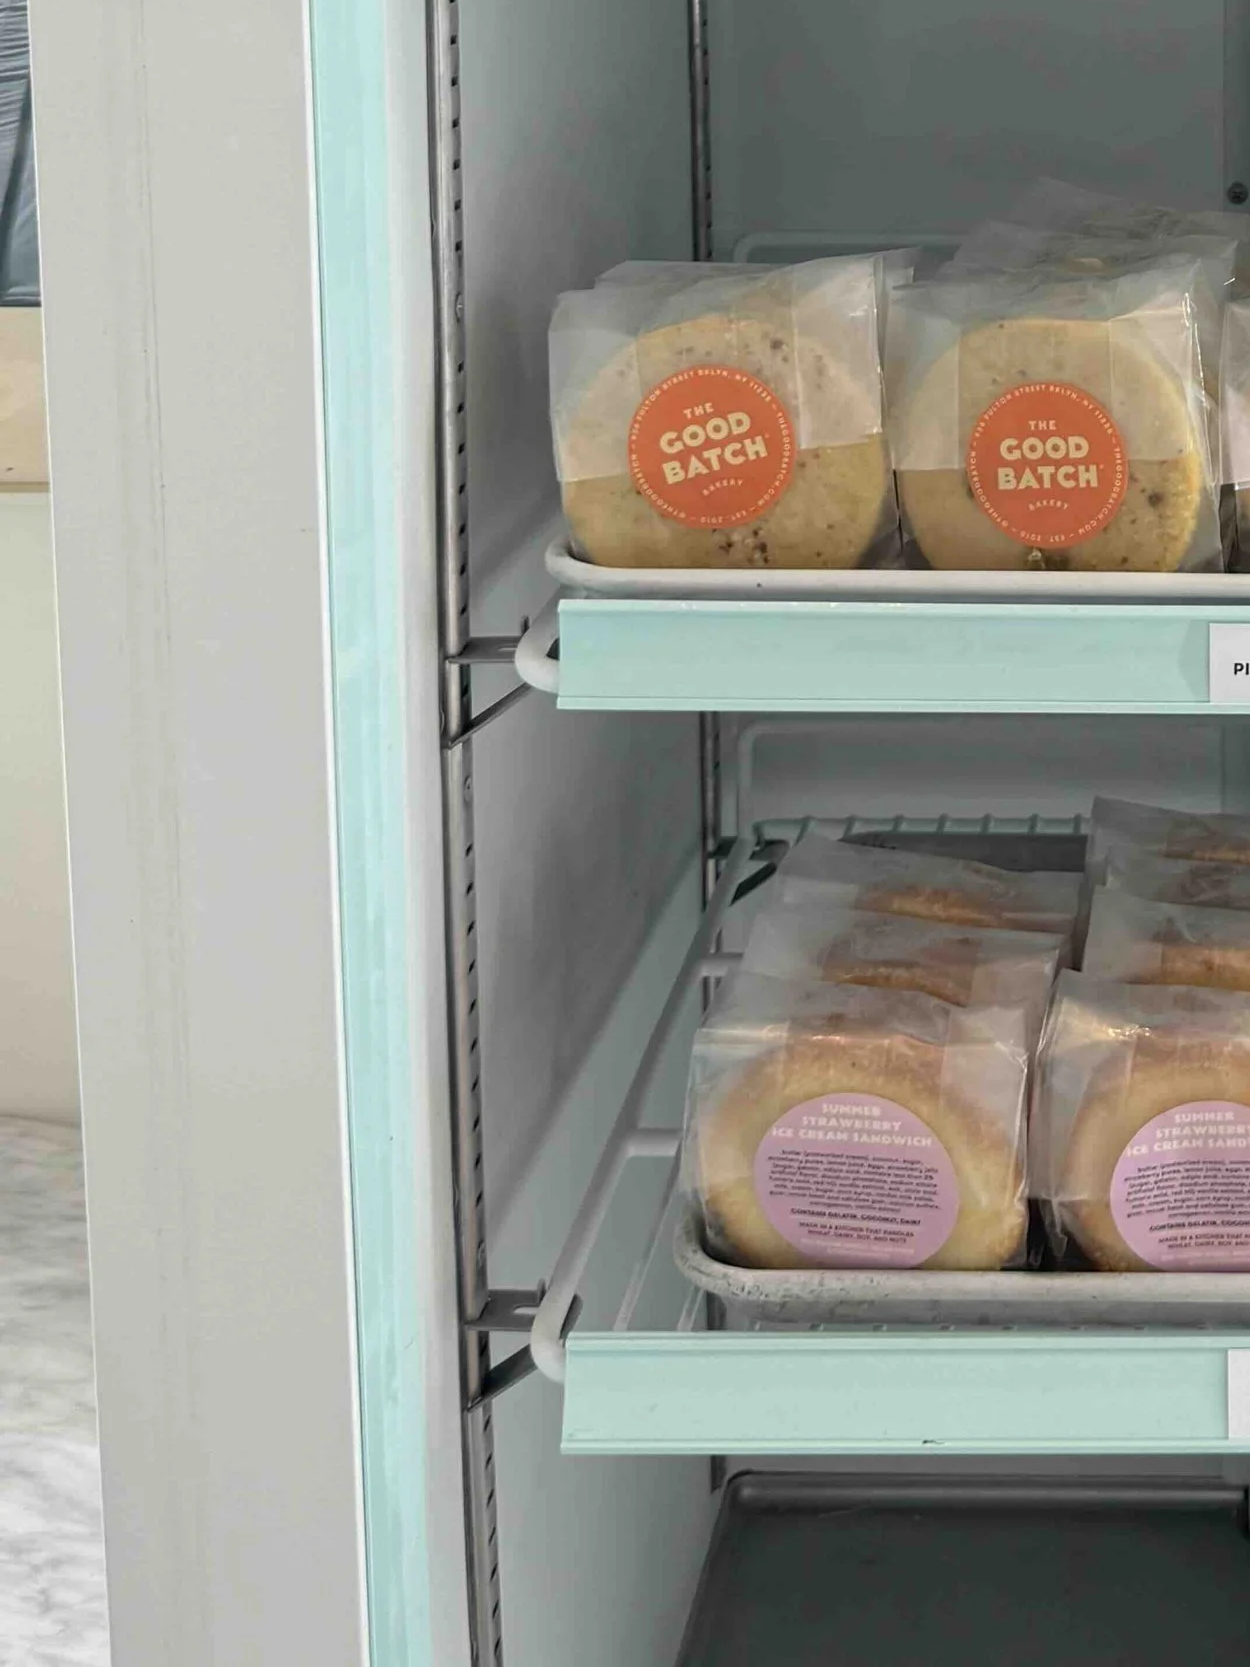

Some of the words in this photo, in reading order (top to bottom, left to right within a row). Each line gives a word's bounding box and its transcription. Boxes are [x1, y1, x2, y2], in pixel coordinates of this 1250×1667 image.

[683, 403, 714, 419] THE
[659, 411, 751, 455] GOOD
[1028, 420, 1056, 431] THE
[1000, 436, 1089, 460] GOOD
[662, 436, 768, 485] BATCH
[997, 465, 1098, 490] BATCH
[702, 478, 744, 497] BAKERY
[1028, 499, 1069, 511] BAKERY
[822, 1104, 881, 1116] SUMMER
[1174, 1111, 1234, 1123] SUMMER
[802, 1116, 902, 1131] STRAWBERRY
[772, 1127, 794, 1137] ICE
[799, 1130, 848, 1141] CREAM
[853, 1133, 933, 1147] SANDWICH
[1127, 1145, 1147, 1157] ICE
[1153, 1139, 1204, 1152] CREAM
